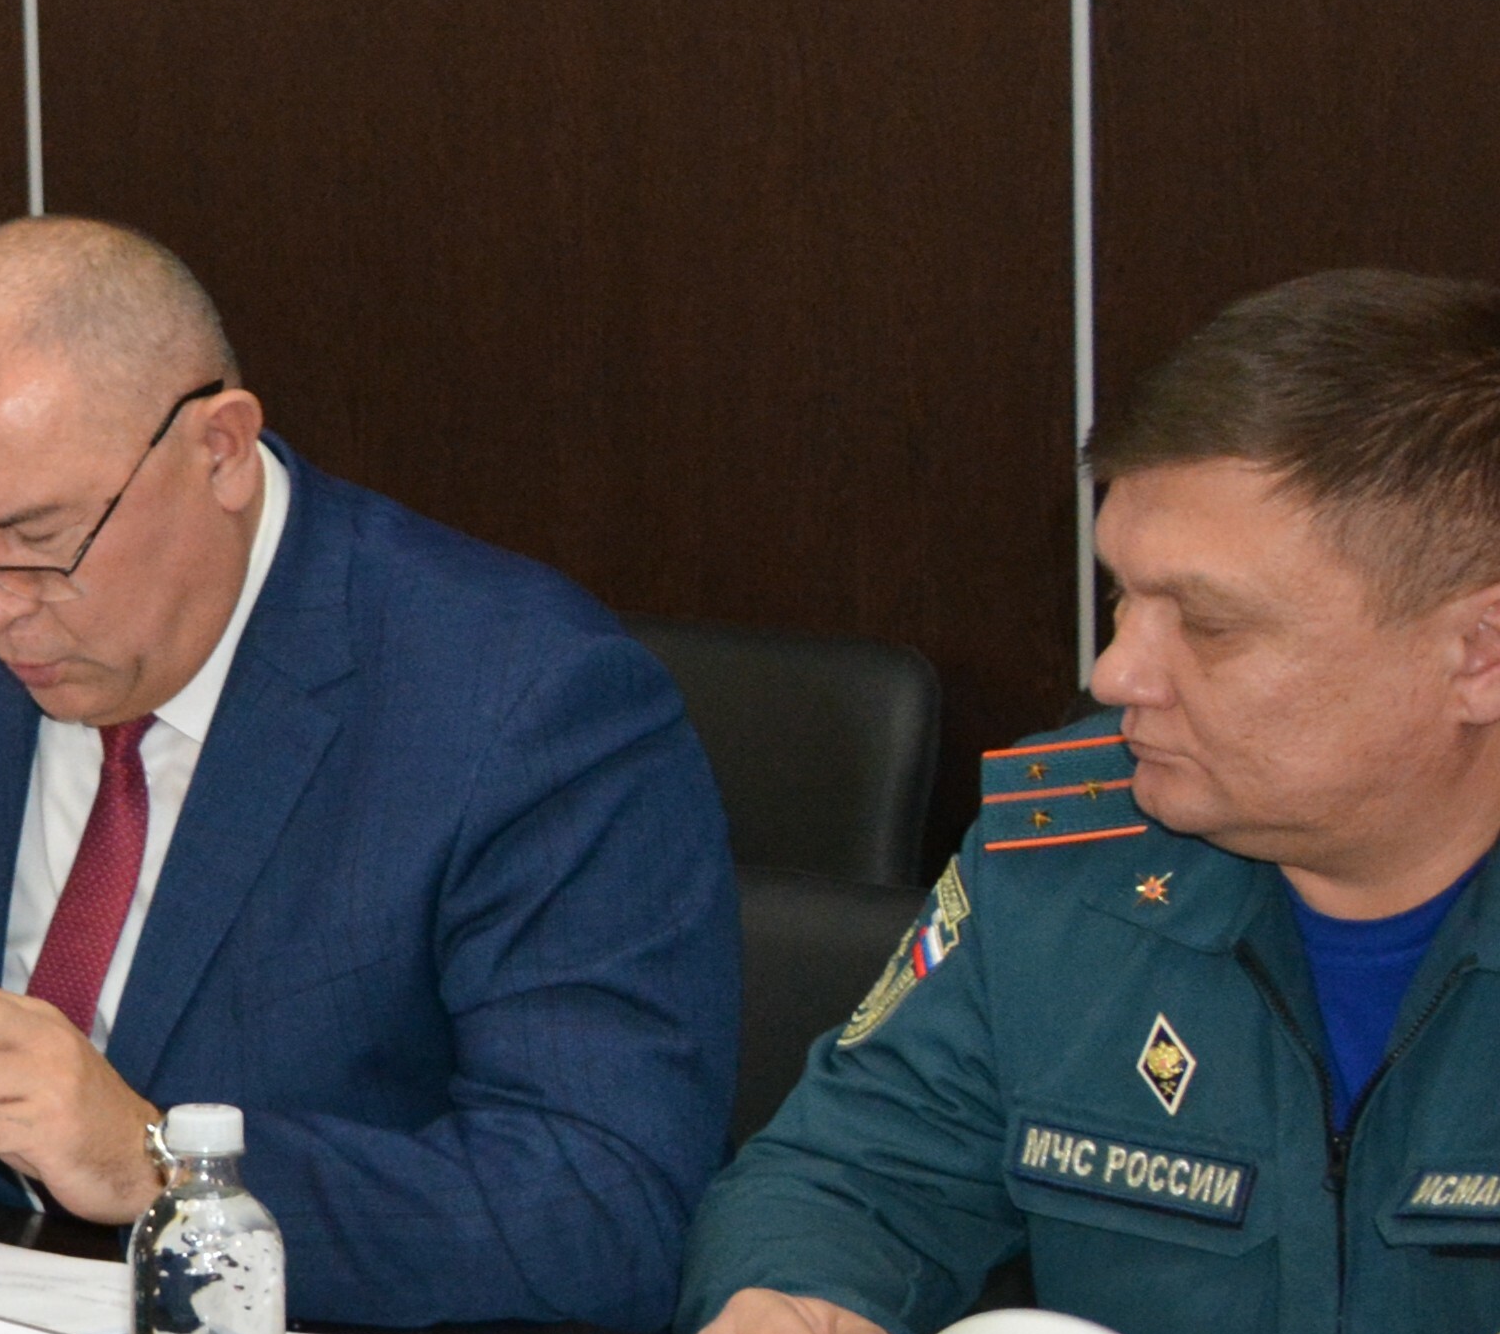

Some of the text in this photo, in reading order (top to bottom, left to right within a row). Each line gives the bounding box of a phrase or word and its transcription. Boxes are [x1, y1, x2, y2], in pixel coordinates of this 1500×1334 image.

[1021, 1127, 1241, 1208] МЧС РОССИИ
[1411, 1174, 1500, 1206] ИСМА
